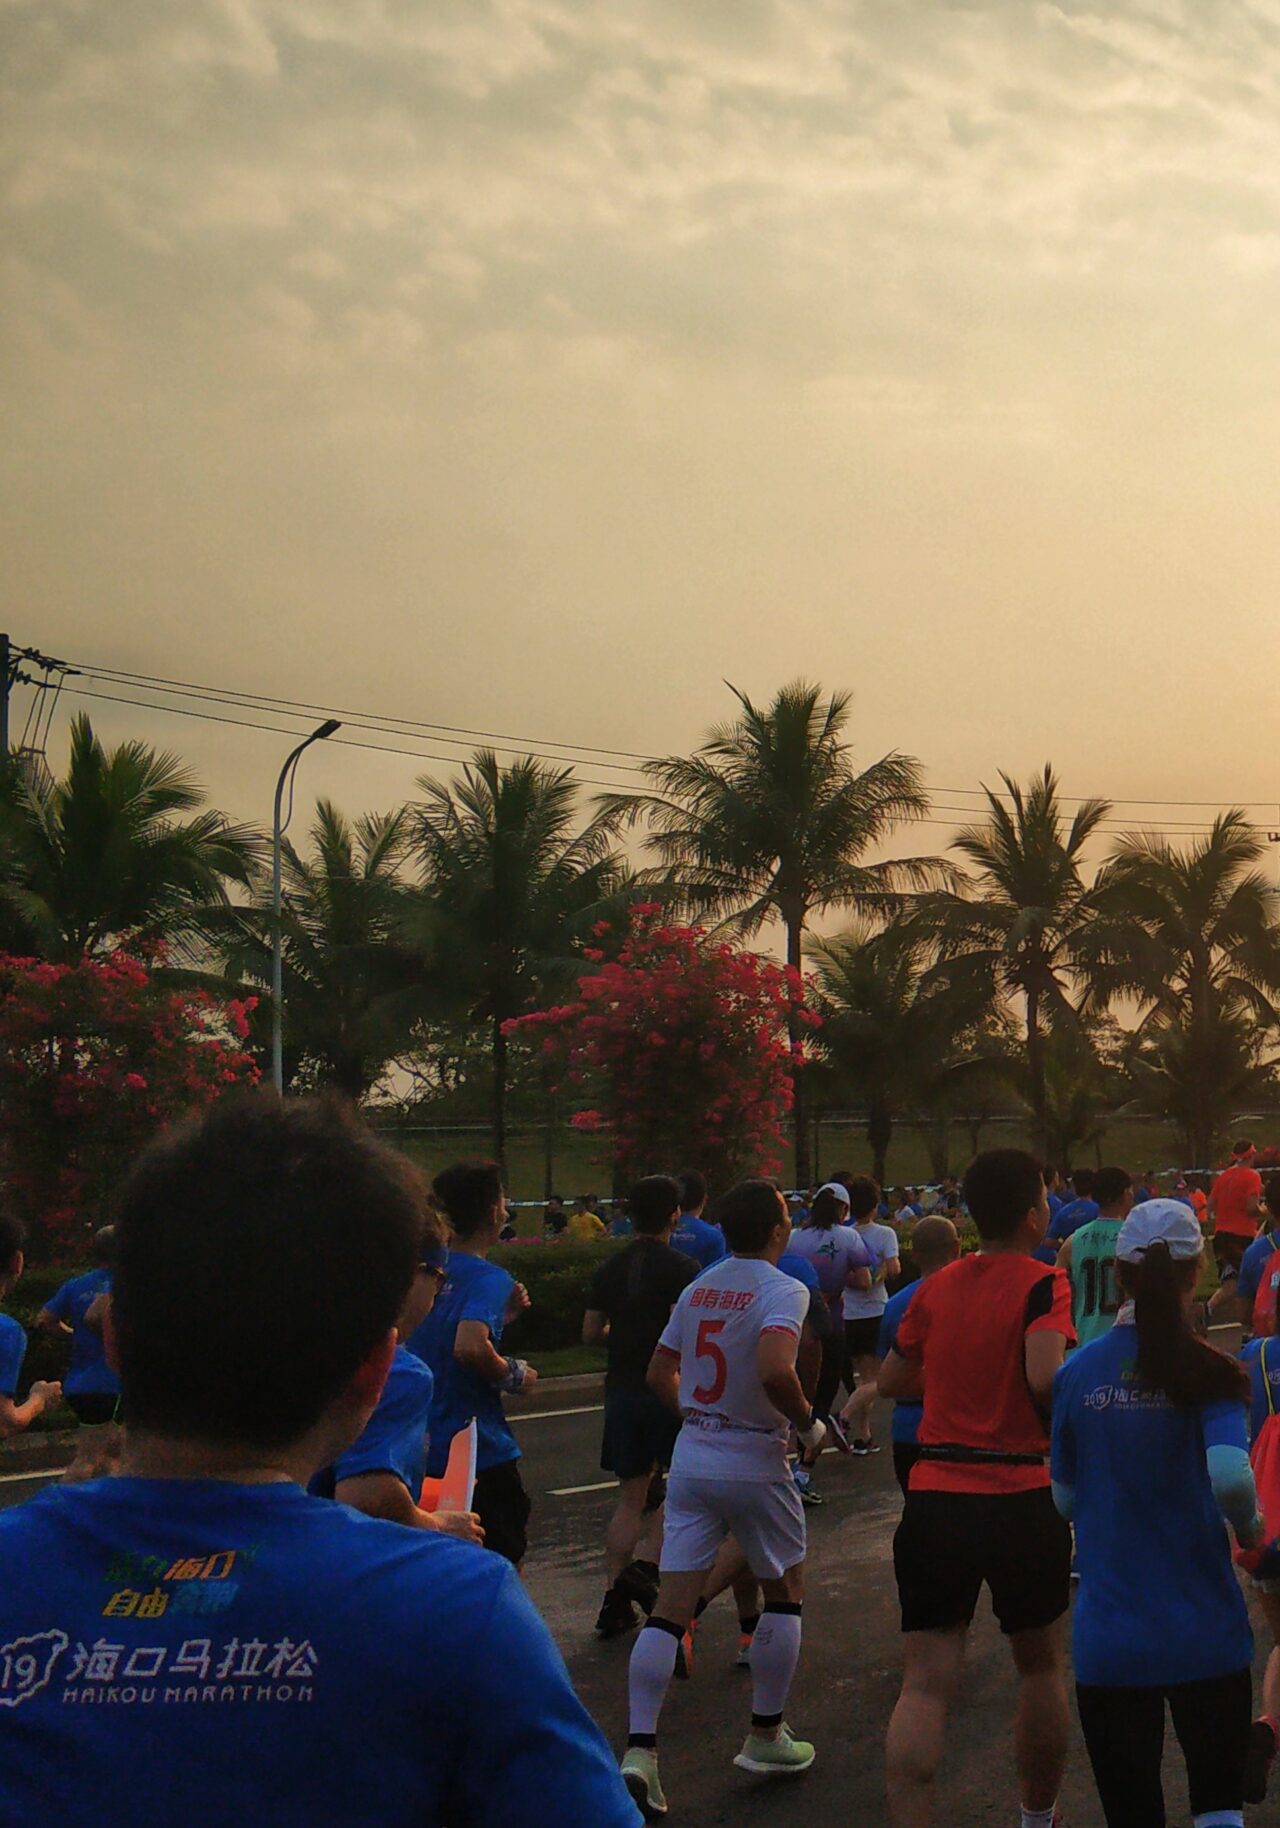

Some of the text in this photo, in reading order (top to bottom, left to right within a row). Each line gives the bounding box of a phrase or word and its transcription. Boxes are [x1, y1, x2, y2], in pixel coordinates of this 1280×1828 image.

[692, 1319, 728, 1406] 5
[1083, 1392, 1107, 1406] 2019
[66, 1637, 318, 1681] 海口马拉松
[62, 1685, 313, 1704] HAIKOU MARATHON
